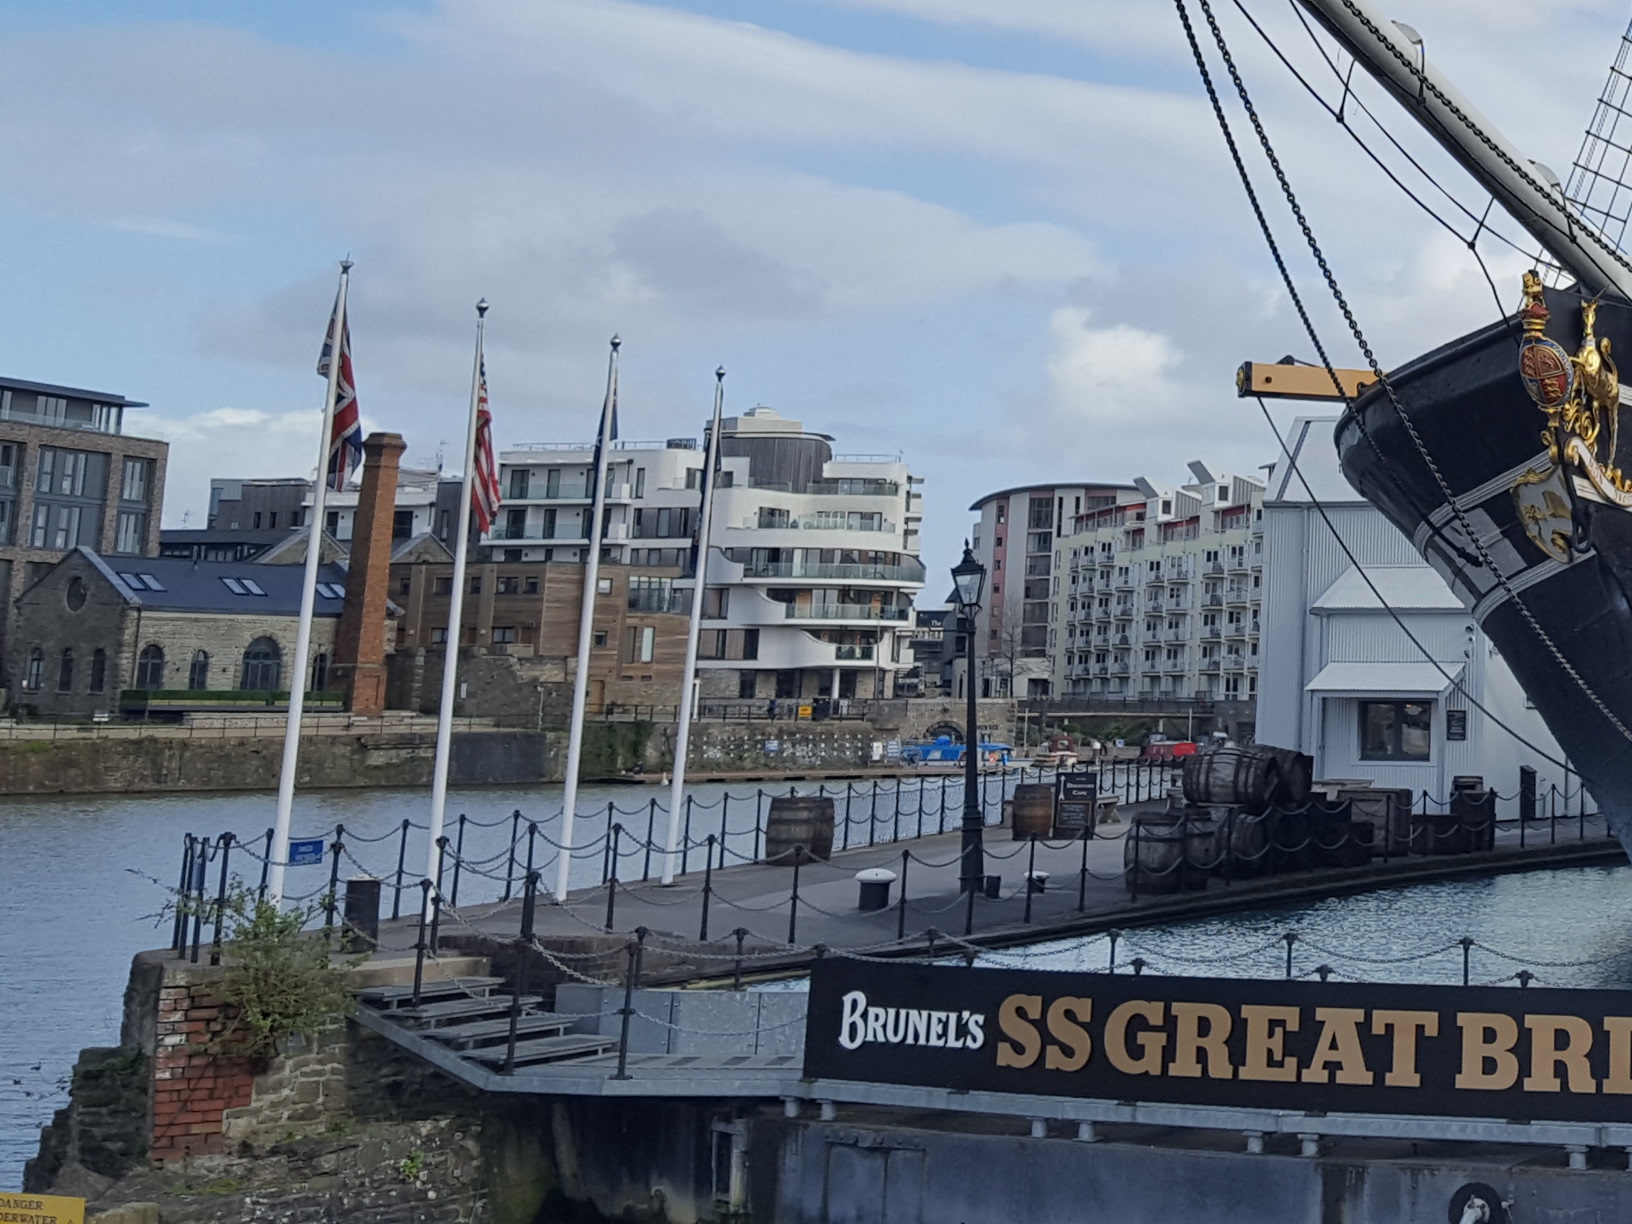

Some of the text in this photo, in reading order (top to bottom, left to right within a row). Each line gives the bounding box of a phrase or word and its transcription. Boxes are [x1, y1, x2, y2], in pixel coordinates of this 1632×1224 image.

[839, 990, 985, 1050] BRUNEL'S
[996, 994, 1092, 1072] SS
[1104, 1000, 1439, 1087] GREAT
